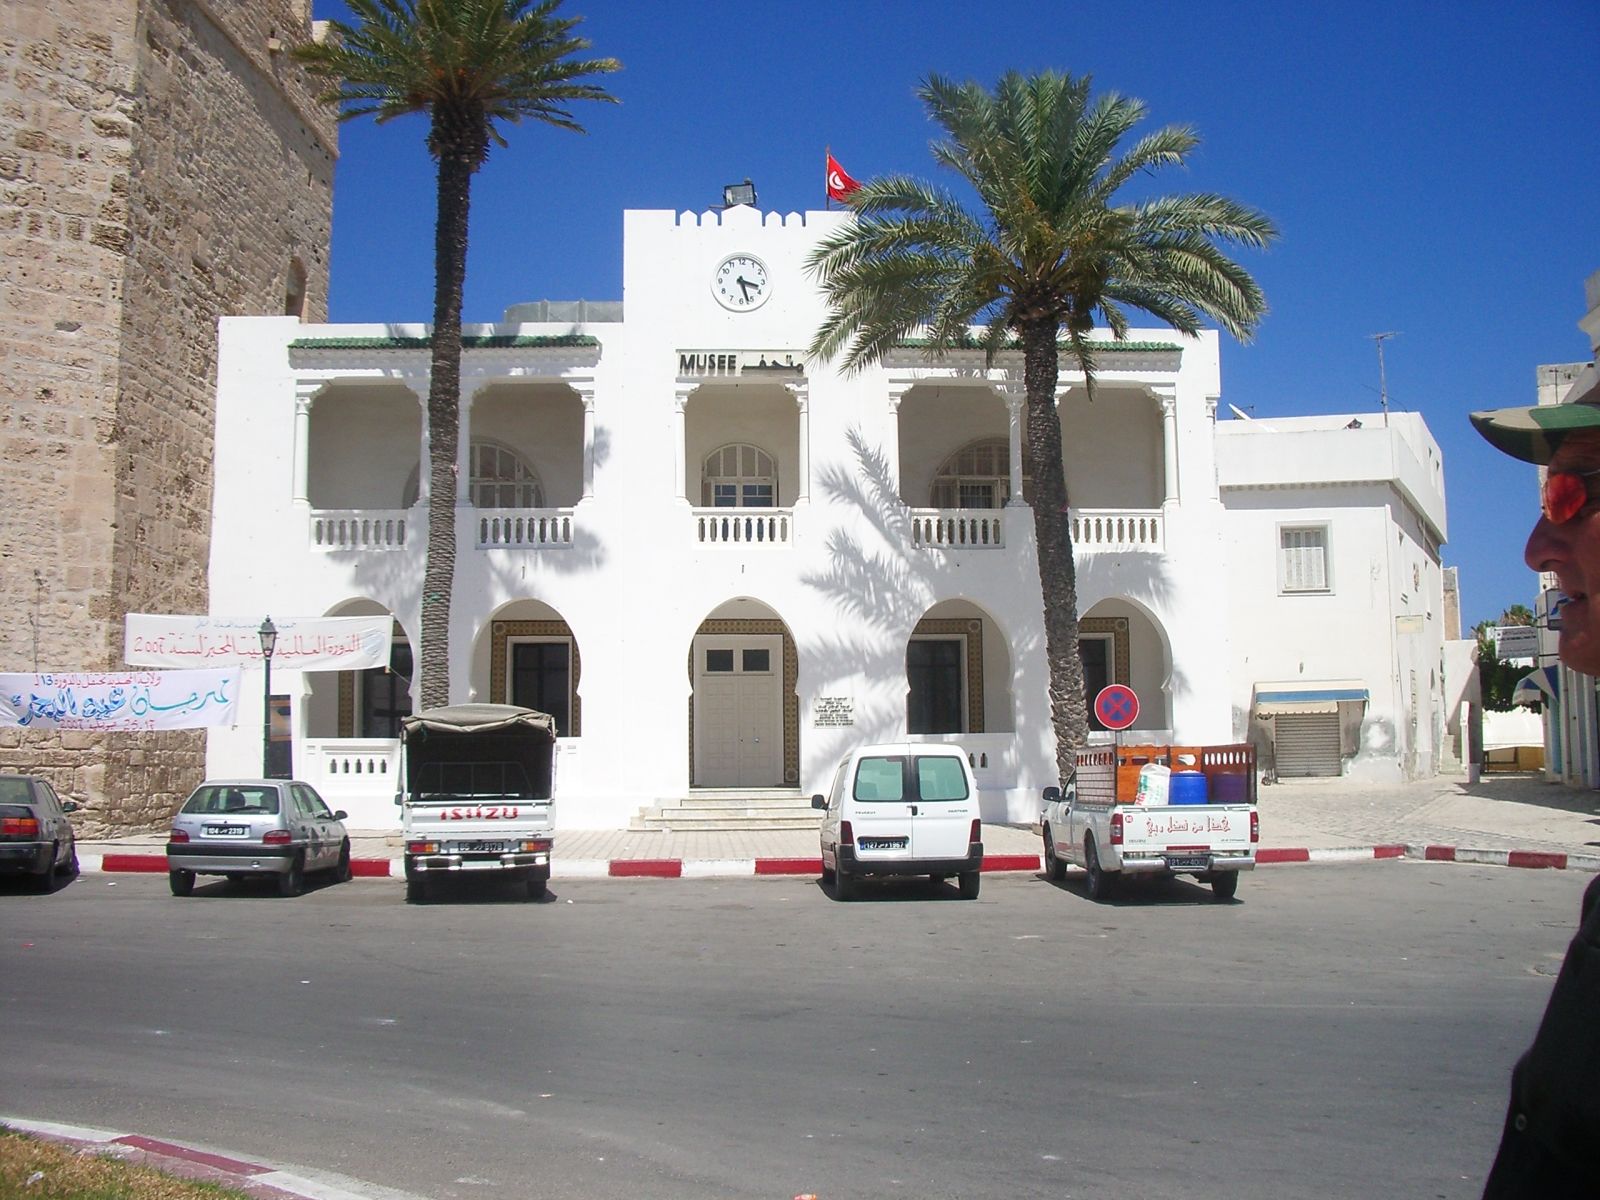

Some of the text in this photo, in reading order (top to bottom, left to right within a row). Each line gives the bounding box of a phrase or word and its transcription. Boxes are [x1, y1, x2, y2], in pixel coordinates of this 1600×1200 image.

[729, 261, 735, 269] 11
[751, 261, 755, 269] 1
[680, 354, 737, 370] MUSEE
[741, 354, 804, 371] متحف
[134, 636, 165, 654] 2007
[41, 674, 54, 686] 13
[441, 807, 518, 821] ISUZU
